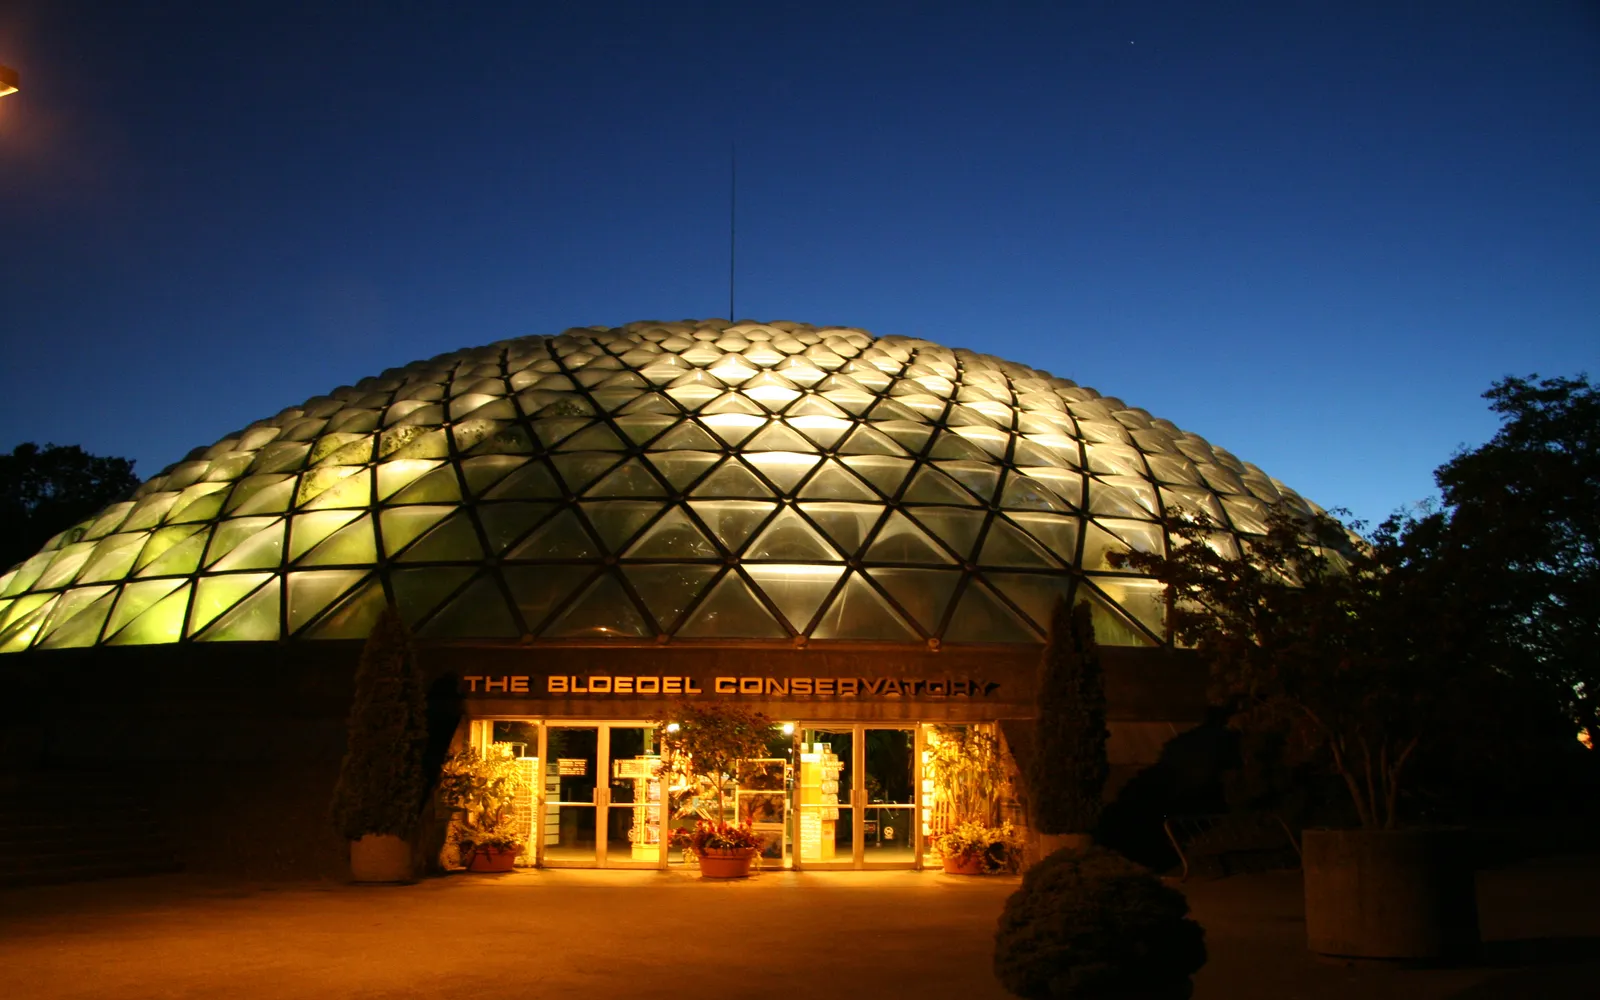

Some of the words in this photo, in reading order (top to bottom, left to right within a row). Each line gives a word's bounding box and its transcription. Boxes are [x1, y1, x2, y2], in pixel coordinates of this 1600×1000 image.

[464, 675, 530, 693] THE
[547, 675, 703, 694] BLOEDEL
[714, 676, 998, 697] CONSERVATORY
